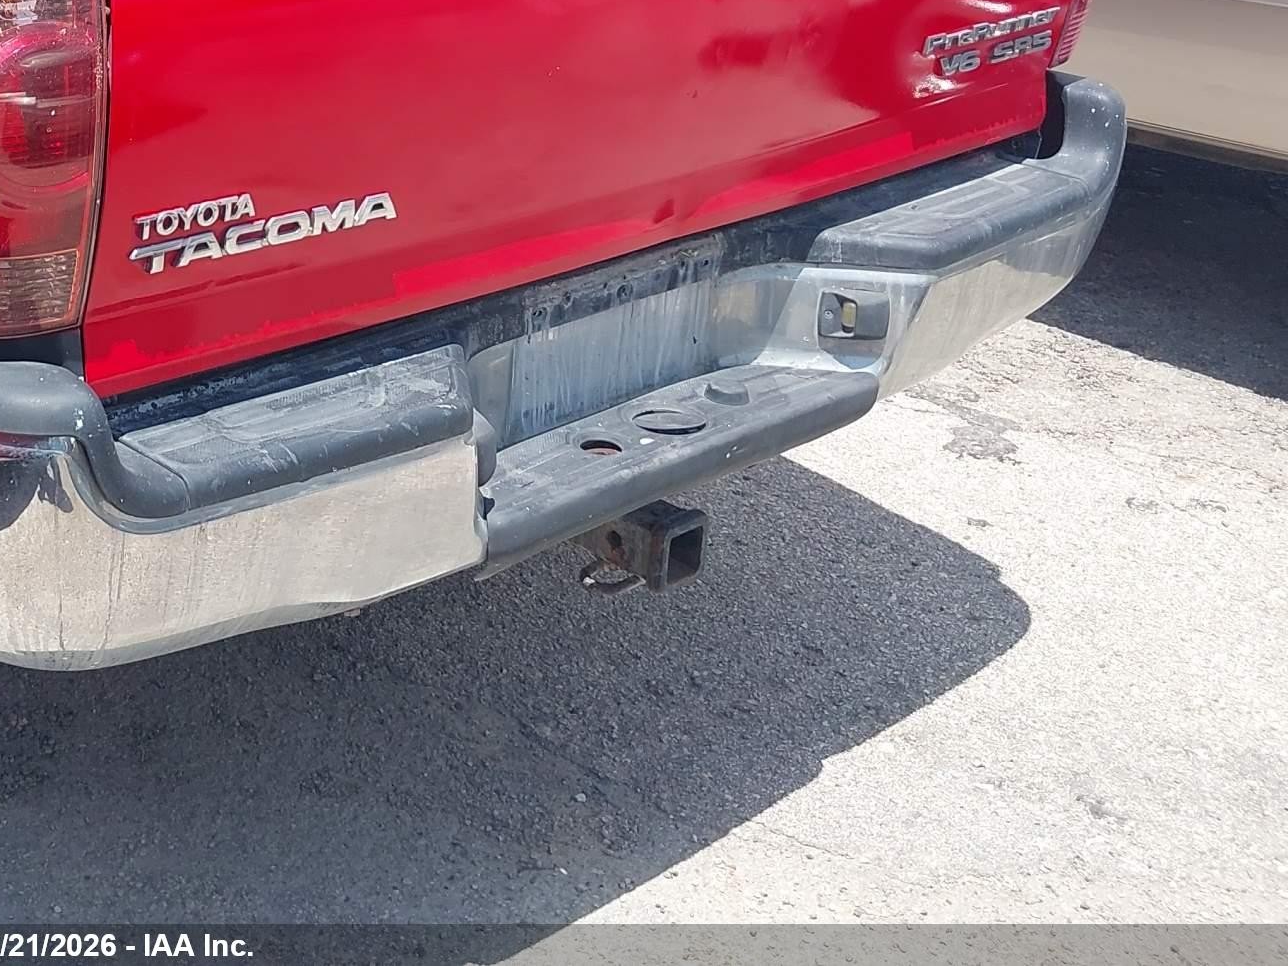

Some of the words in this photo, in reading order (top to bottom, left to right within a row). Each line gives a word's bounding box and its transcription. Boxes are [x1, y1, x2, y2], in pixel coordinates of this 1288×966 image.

[940, 50, 981, 76] V6
[988, 30, 1053, 65] SR5
[128, 191, 398, 275] TACOMA
[133, 192, 256, 241] TOYOTA
